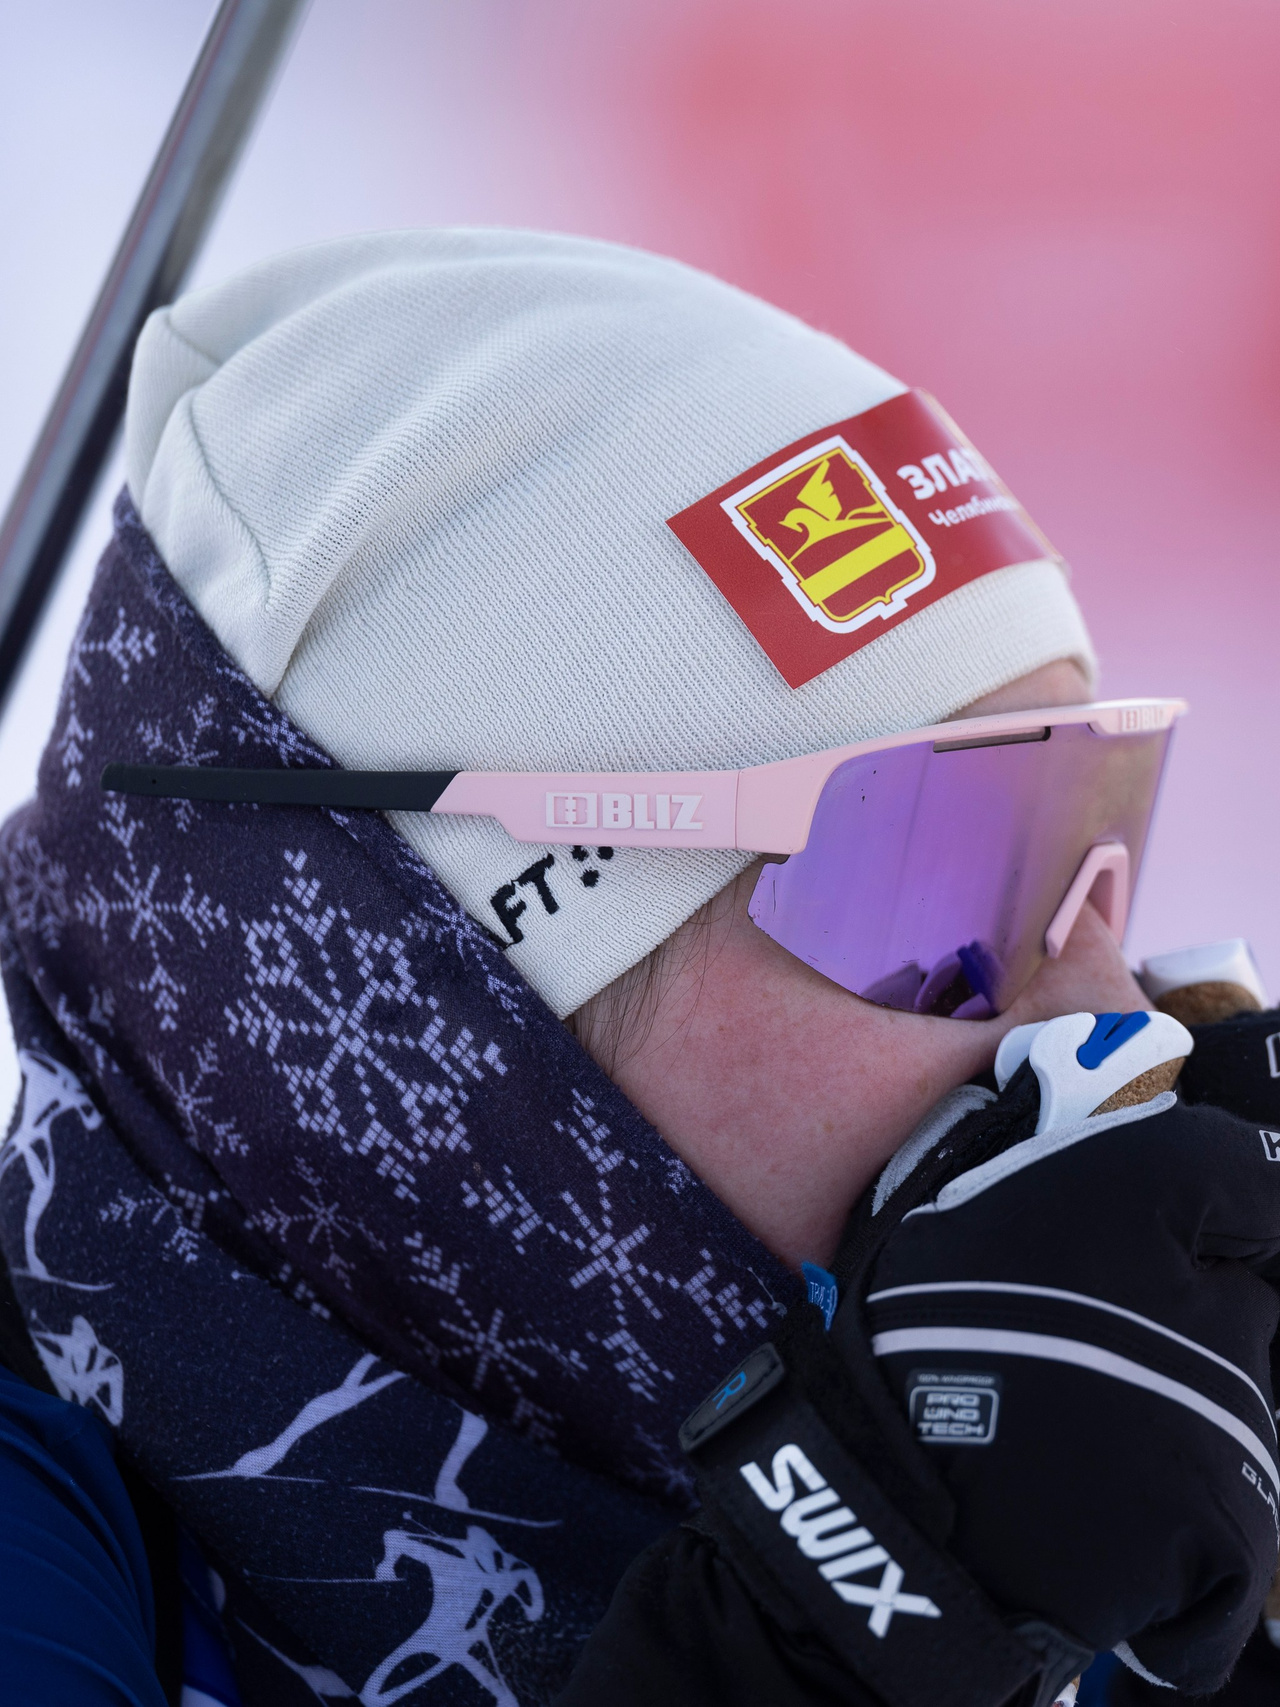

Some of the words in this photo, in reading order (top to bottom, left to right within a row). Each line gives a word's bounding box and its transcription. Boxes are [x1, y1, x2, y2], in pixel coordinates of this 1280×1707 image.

[602, 792, 703, 831] BLIZ
[488, 853, 560, 945] FT
[926, 1392, 981, 1407] PRO
[917, 1421, 985, 1436] TECH
[740, 1443, 942, 1639] SWIX
